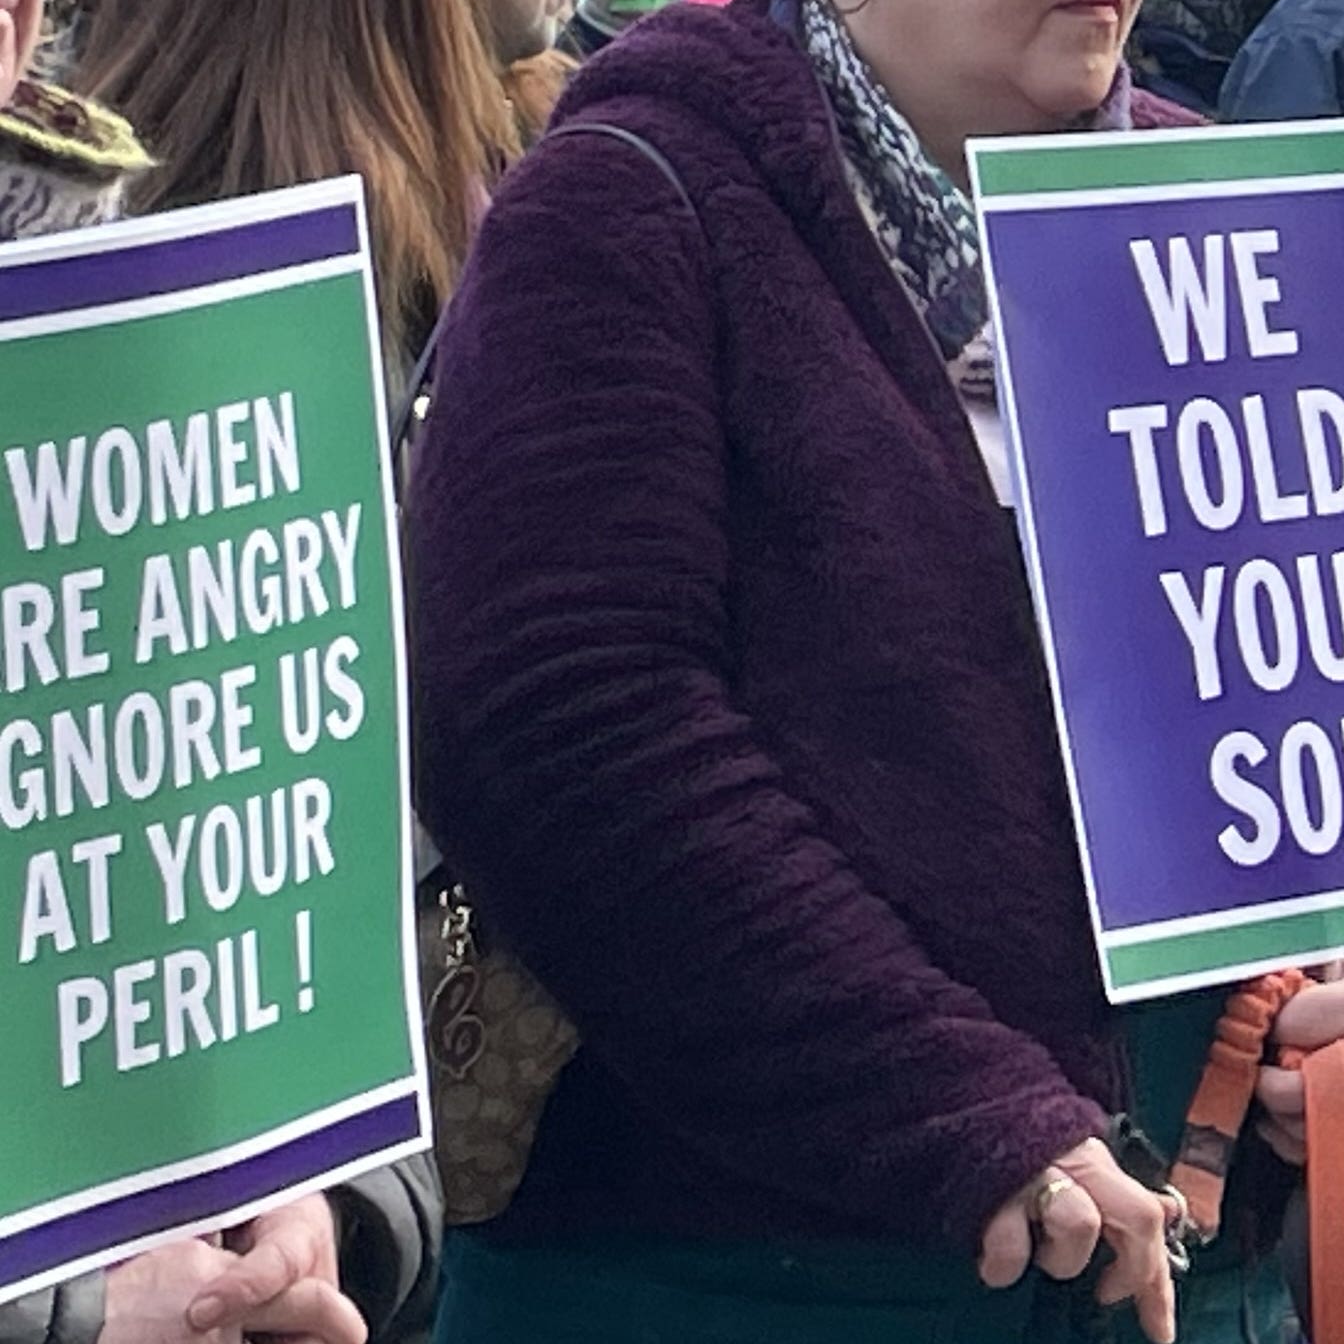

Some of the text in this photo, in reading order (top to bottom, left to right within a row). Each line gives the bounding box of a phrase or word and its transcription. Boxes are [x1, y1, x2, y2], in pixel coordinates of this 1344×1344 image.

[1131, 229, 1300, 368] WE
[7, 391, 300, 551] WOMEN
[0, 503, 362, 693] RE ANGRY
[280, 636, 365, 754] US
[19, 777, 335, 964] AT YOUR
